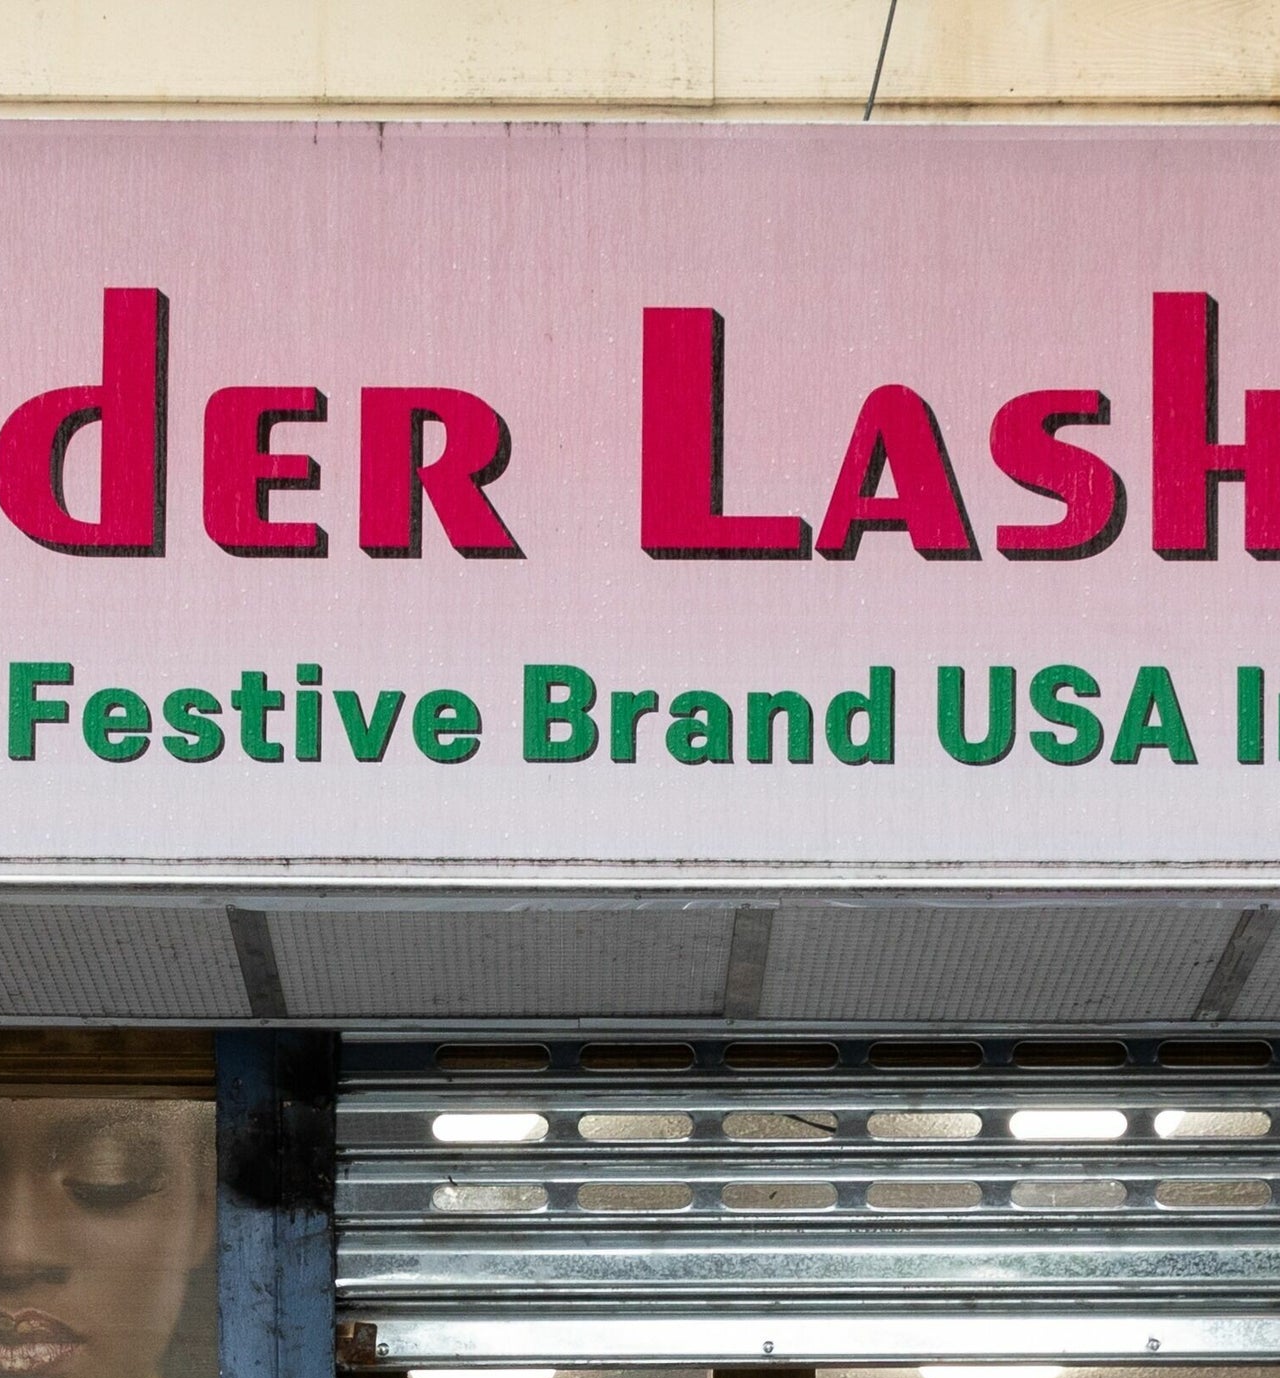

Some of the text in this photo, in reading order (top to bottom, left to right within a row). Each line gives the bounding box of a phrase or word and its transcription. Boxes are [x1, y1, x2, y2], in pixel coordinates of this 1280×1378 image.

[8, 661, 482, 764] Festive
[523, 664, 896, 766] Brand
[936, 664, 1198, 767] USA
